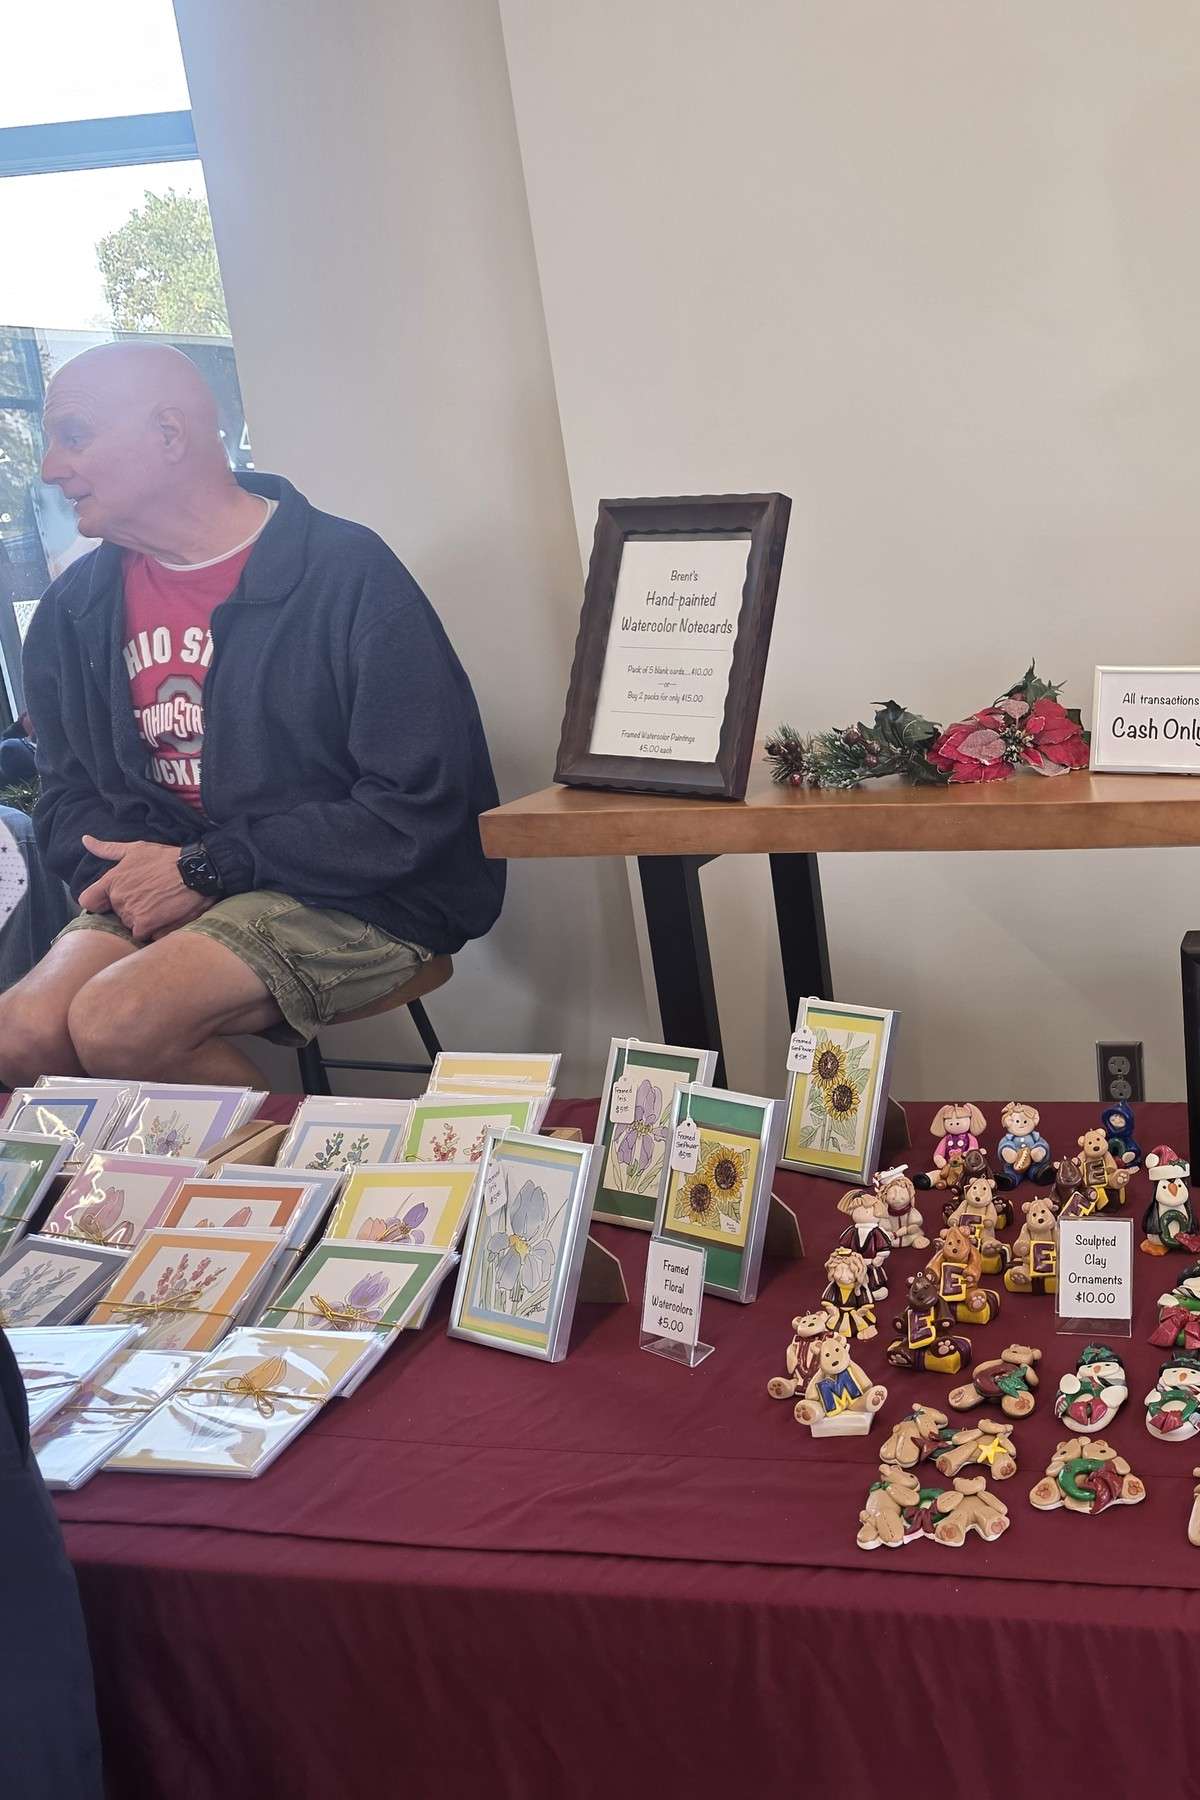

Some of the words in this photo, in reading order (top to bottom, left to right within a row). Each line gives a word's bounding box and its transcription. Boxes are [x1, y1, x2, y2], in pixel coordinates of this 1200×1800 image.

[670, 569, 699, 582] Brent's
[646, 590, 717, 611] Hand-painted
[621, 616, 678, 633] Watercolor
[679, 618, 733, 634] Notecards
[627, 664, 641, 674] Pack
[642, 665, 649, 674] of
[654, 665, 669, 675] blank
[627, 690, 638, 701] Buy
[660, 692, 668, 701] for
[669, 694, 681, 703] only
[1122, 692, 1136, 705] All
[1140, 695, 1200, 706] transactions
[174, 696, 204, 738] STA
[1112, 716, 1158, 740] Cash
[621, 729, 641, 739] Framed
[670, 732, 696, 744] Paintings
[640, 744, 660, 753] $5.00
[660, 746, 672, 754] each
[1075, 1234, 1117, 1250] Sculpted
[1032, 1242, 1056, 1274] E
[1084, 1253, 1107, 1268] Clay
[663, 1259, 690, 1276] Framed
[664, 1279, 685, 1294] Floral
[942, 1263, 968, 1299] E
[1068, 1272, 1123, 1285] Ornaments
[651, 1295, 693, 1316] Watercolors
[1075, 1291, 1116, 1304] $10.00
[657, 1315, 684, 1333] $5.00
[816, 1368, 862, 1414] M
